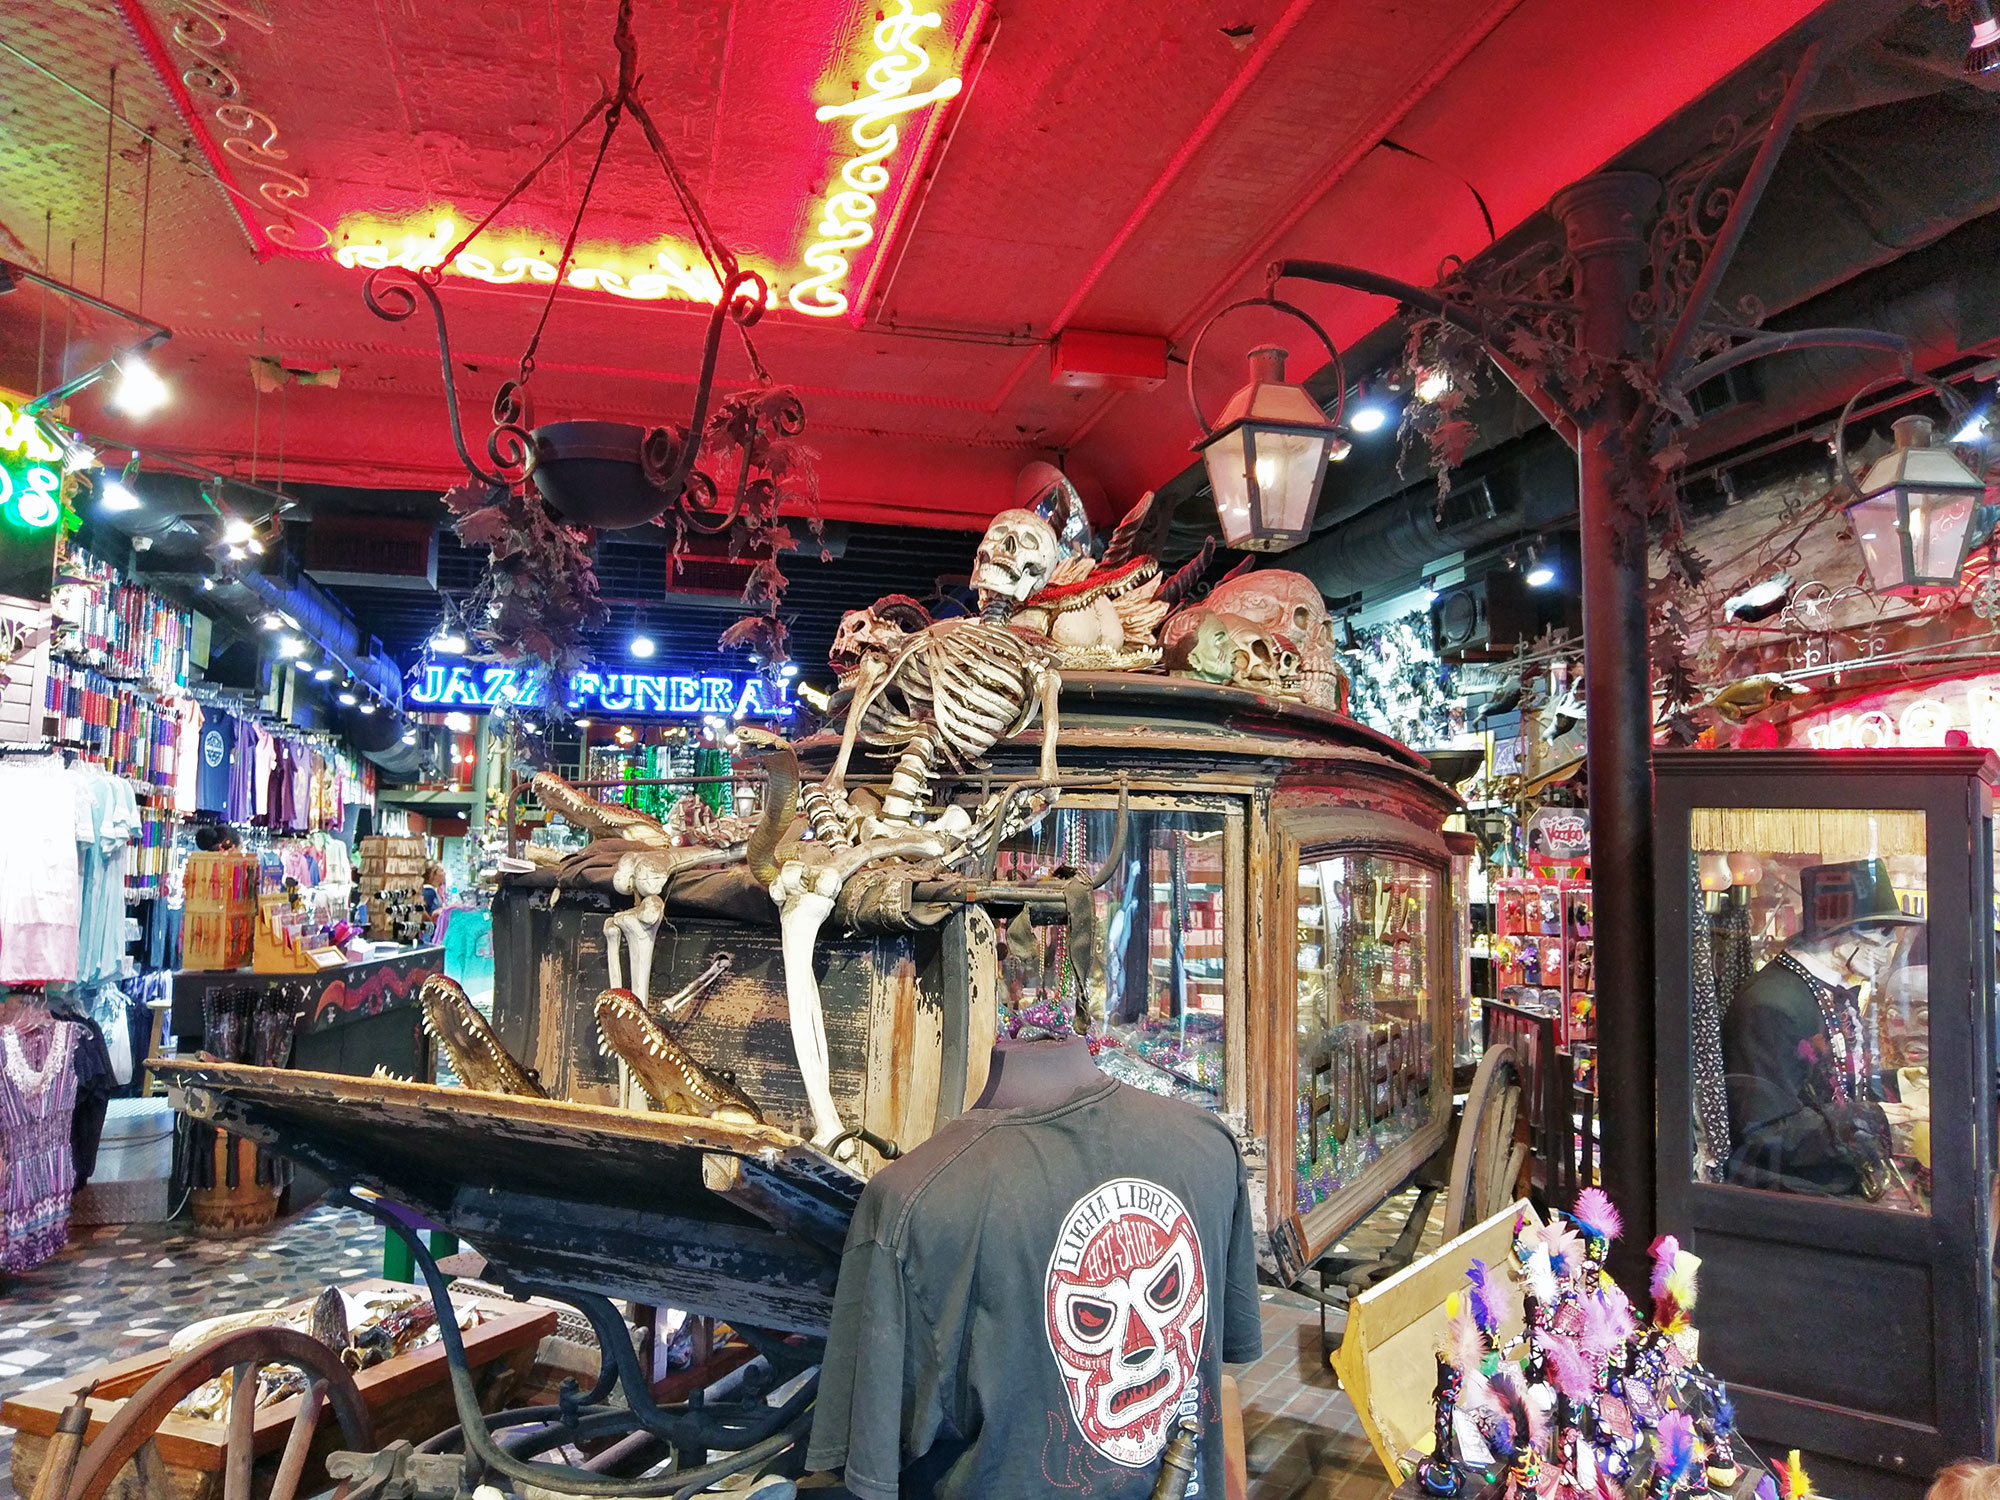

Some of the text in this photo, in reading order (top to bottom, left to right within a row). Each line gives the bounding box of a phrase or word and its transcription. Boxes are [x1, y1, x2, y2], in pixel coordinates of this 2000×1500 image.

[1058, 1184, 1178, 1268] LUCHA LIBRE
[1084, 1220, 1164, 1282] HOT SAUCE
[1182, 1391, 1196, 1401] LARGE
[1181, 1404, 1196, 1413] LARGE
[1109, 1441, 1125, 1458] NEW
